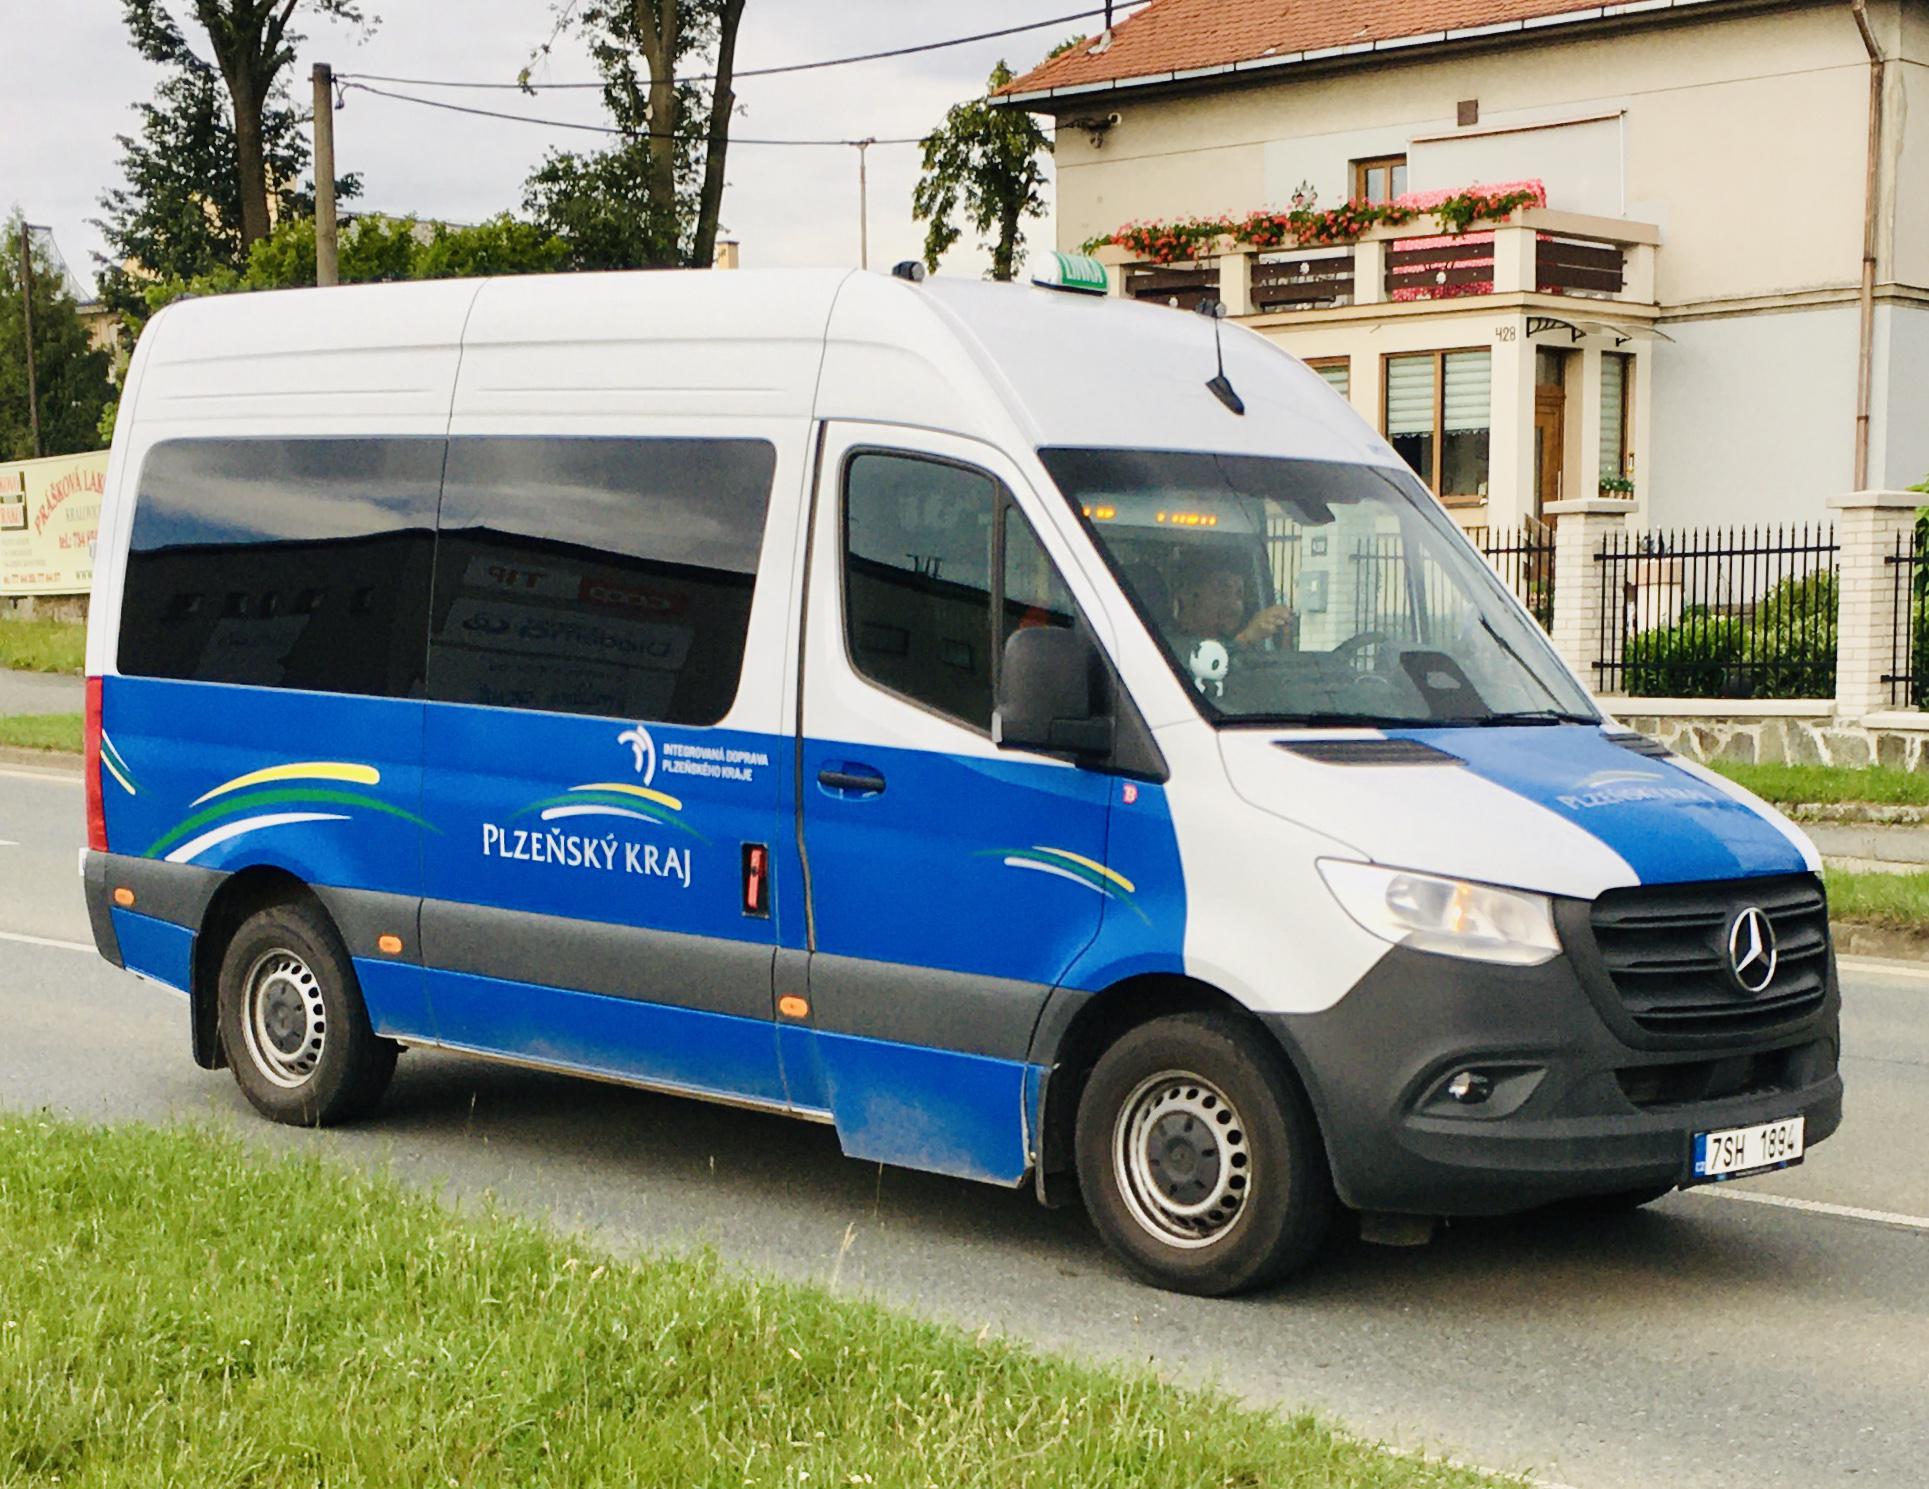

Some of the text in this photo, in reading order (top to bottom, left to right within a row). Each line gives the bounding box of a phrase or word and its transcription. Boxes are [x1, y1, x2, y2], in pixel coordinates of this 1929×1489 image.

[1495, 326, 1516, 342] 428
[663, 743, 769, 766] INTEGROVANÁ DOPRAVA
[662, 759, 753, 782] PLZEŇSKÉHO KRAJE
[482, 823, 691, 888] PLZEŇSKÝ KRAJ
[1711, 1123, 1796, 1170] 7SH 1894
